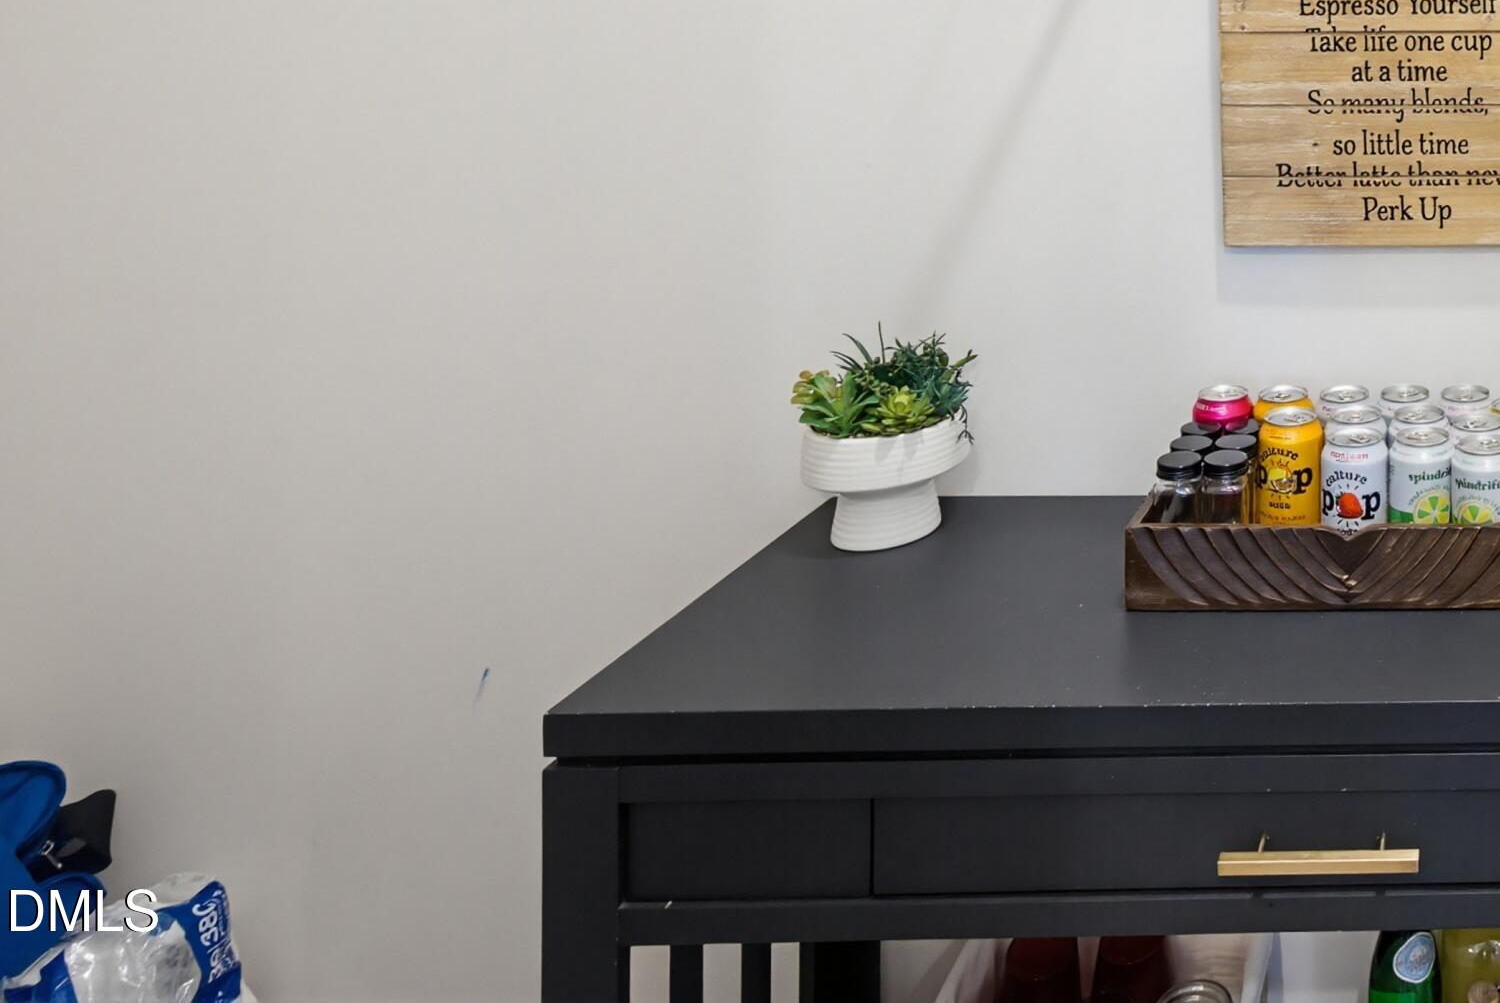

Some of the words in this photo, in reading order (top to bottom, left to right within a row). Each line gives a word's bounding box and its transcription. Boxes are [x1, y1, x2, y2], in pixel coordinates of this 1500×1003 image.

[1305, 26, 1357, 53] Take
[1362, 25, 1398, 52] life
[1404, 34, 1445, 52] one
[1451, 34, 1493, 60] cup
[1351, 60, 1373, 82] at
[1379, 66, 1391, 82] a
[1397, 58, 1448, 82] time
[1308, 89, 1334, 115] So
[1341, 97, 1405, 123] many
[1411, 87, 1488, 116] blends,
[1333, 138, 1356, 156] so
[1361, 129, 1413, 156] little
[1419, 131, 1469, 156] time
[1276, 163, 1346, 188] Better
[1352, 161, 1401, 187] latte
[1408, 160, 1459, 187] than
[1362, 195, 1414, 222] Perk
[1419, 197, 1452, 228] Up
